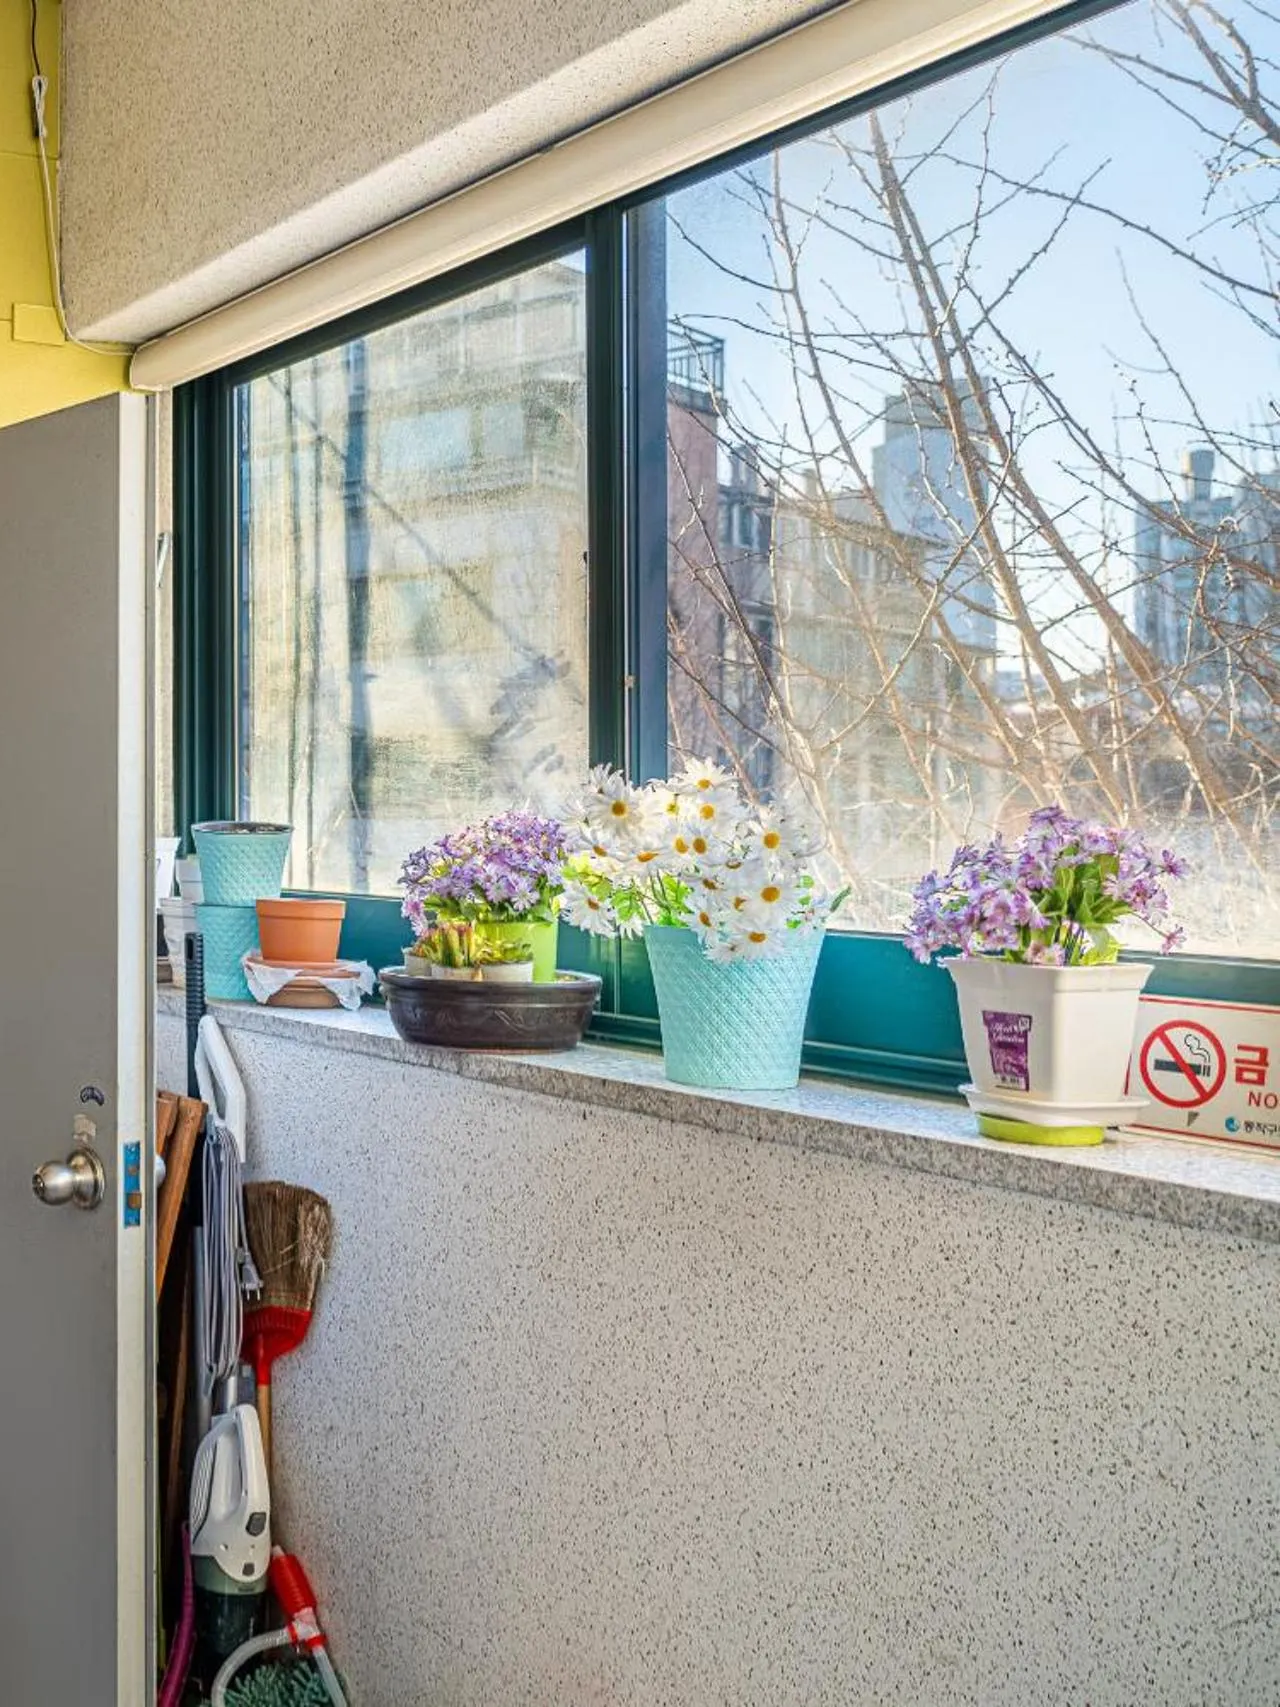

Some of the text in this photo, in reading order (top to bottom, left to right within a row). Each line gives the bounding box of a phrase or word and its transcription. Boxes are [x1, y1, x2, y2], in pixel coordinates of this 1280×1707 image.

[1234, 1044, 1270, 1086] 금
[1248, 1091, 1278, 1109] NO
[1243, 1120, 1280, 1135] 동작구
